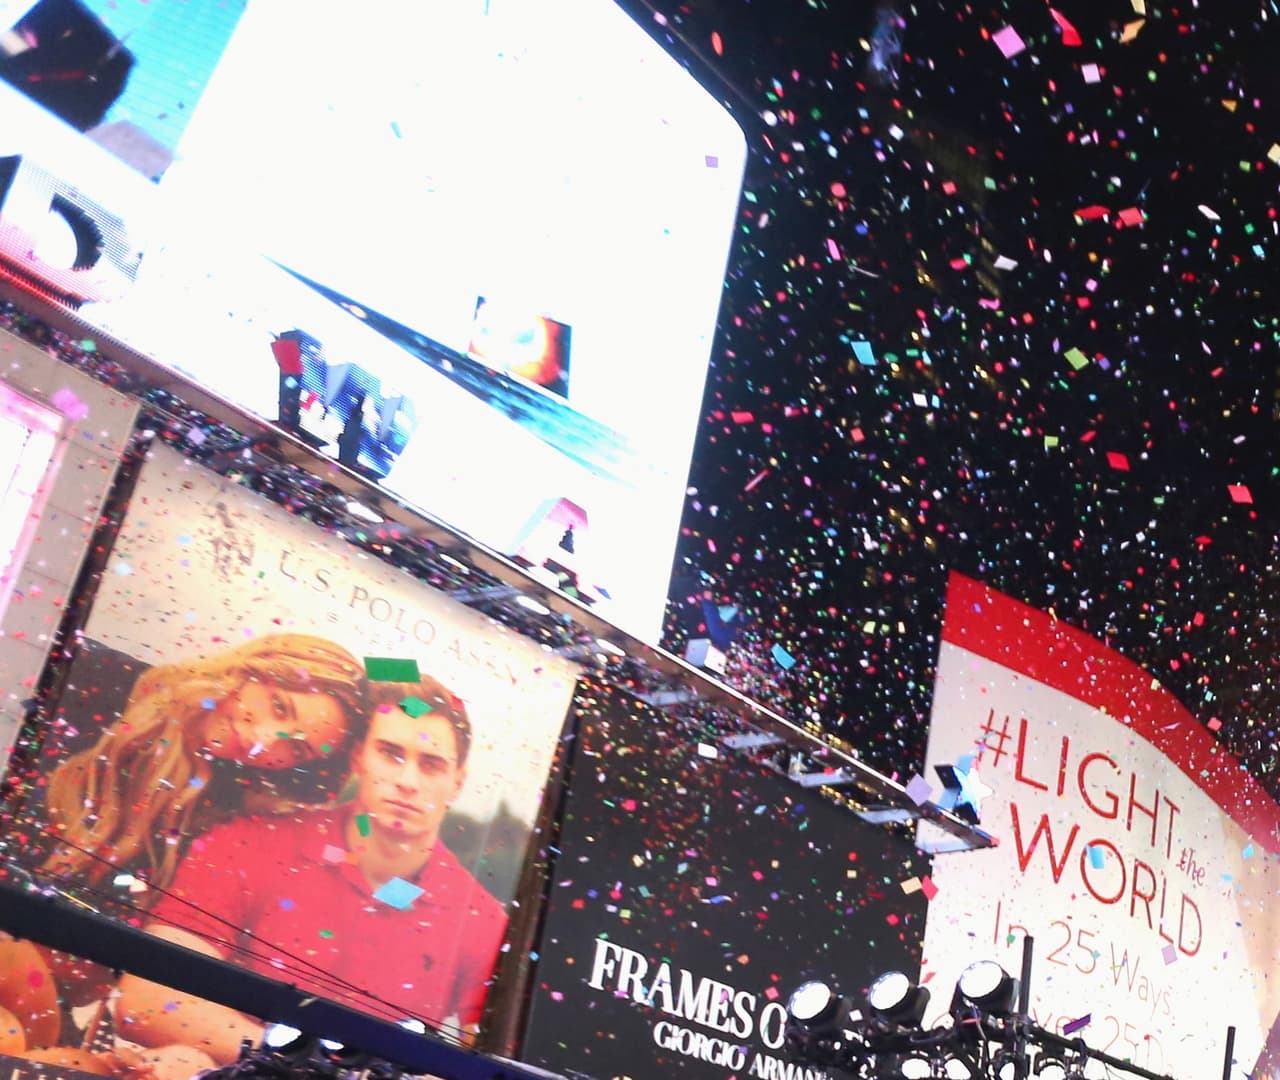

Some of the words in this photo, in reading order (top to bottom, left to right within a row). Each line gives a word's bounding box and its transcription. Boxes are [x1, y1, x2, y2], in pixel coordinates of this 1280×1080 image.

[279, 549, 337, 598] U.S.
[347, 584, 437, 645] POLO
[974, 708, 1181, 860] #LIGHT
[1176, 847, 1206, 887] the
[1010, 802, 1203, 957] WORLD
[588, 938, 757, 1039] FRAMES
[1047, 920, 1100, 974] 25
[1110, 941, 1170, 1016] Ways
[653, 1021, 747, 1071] GIORGIO
